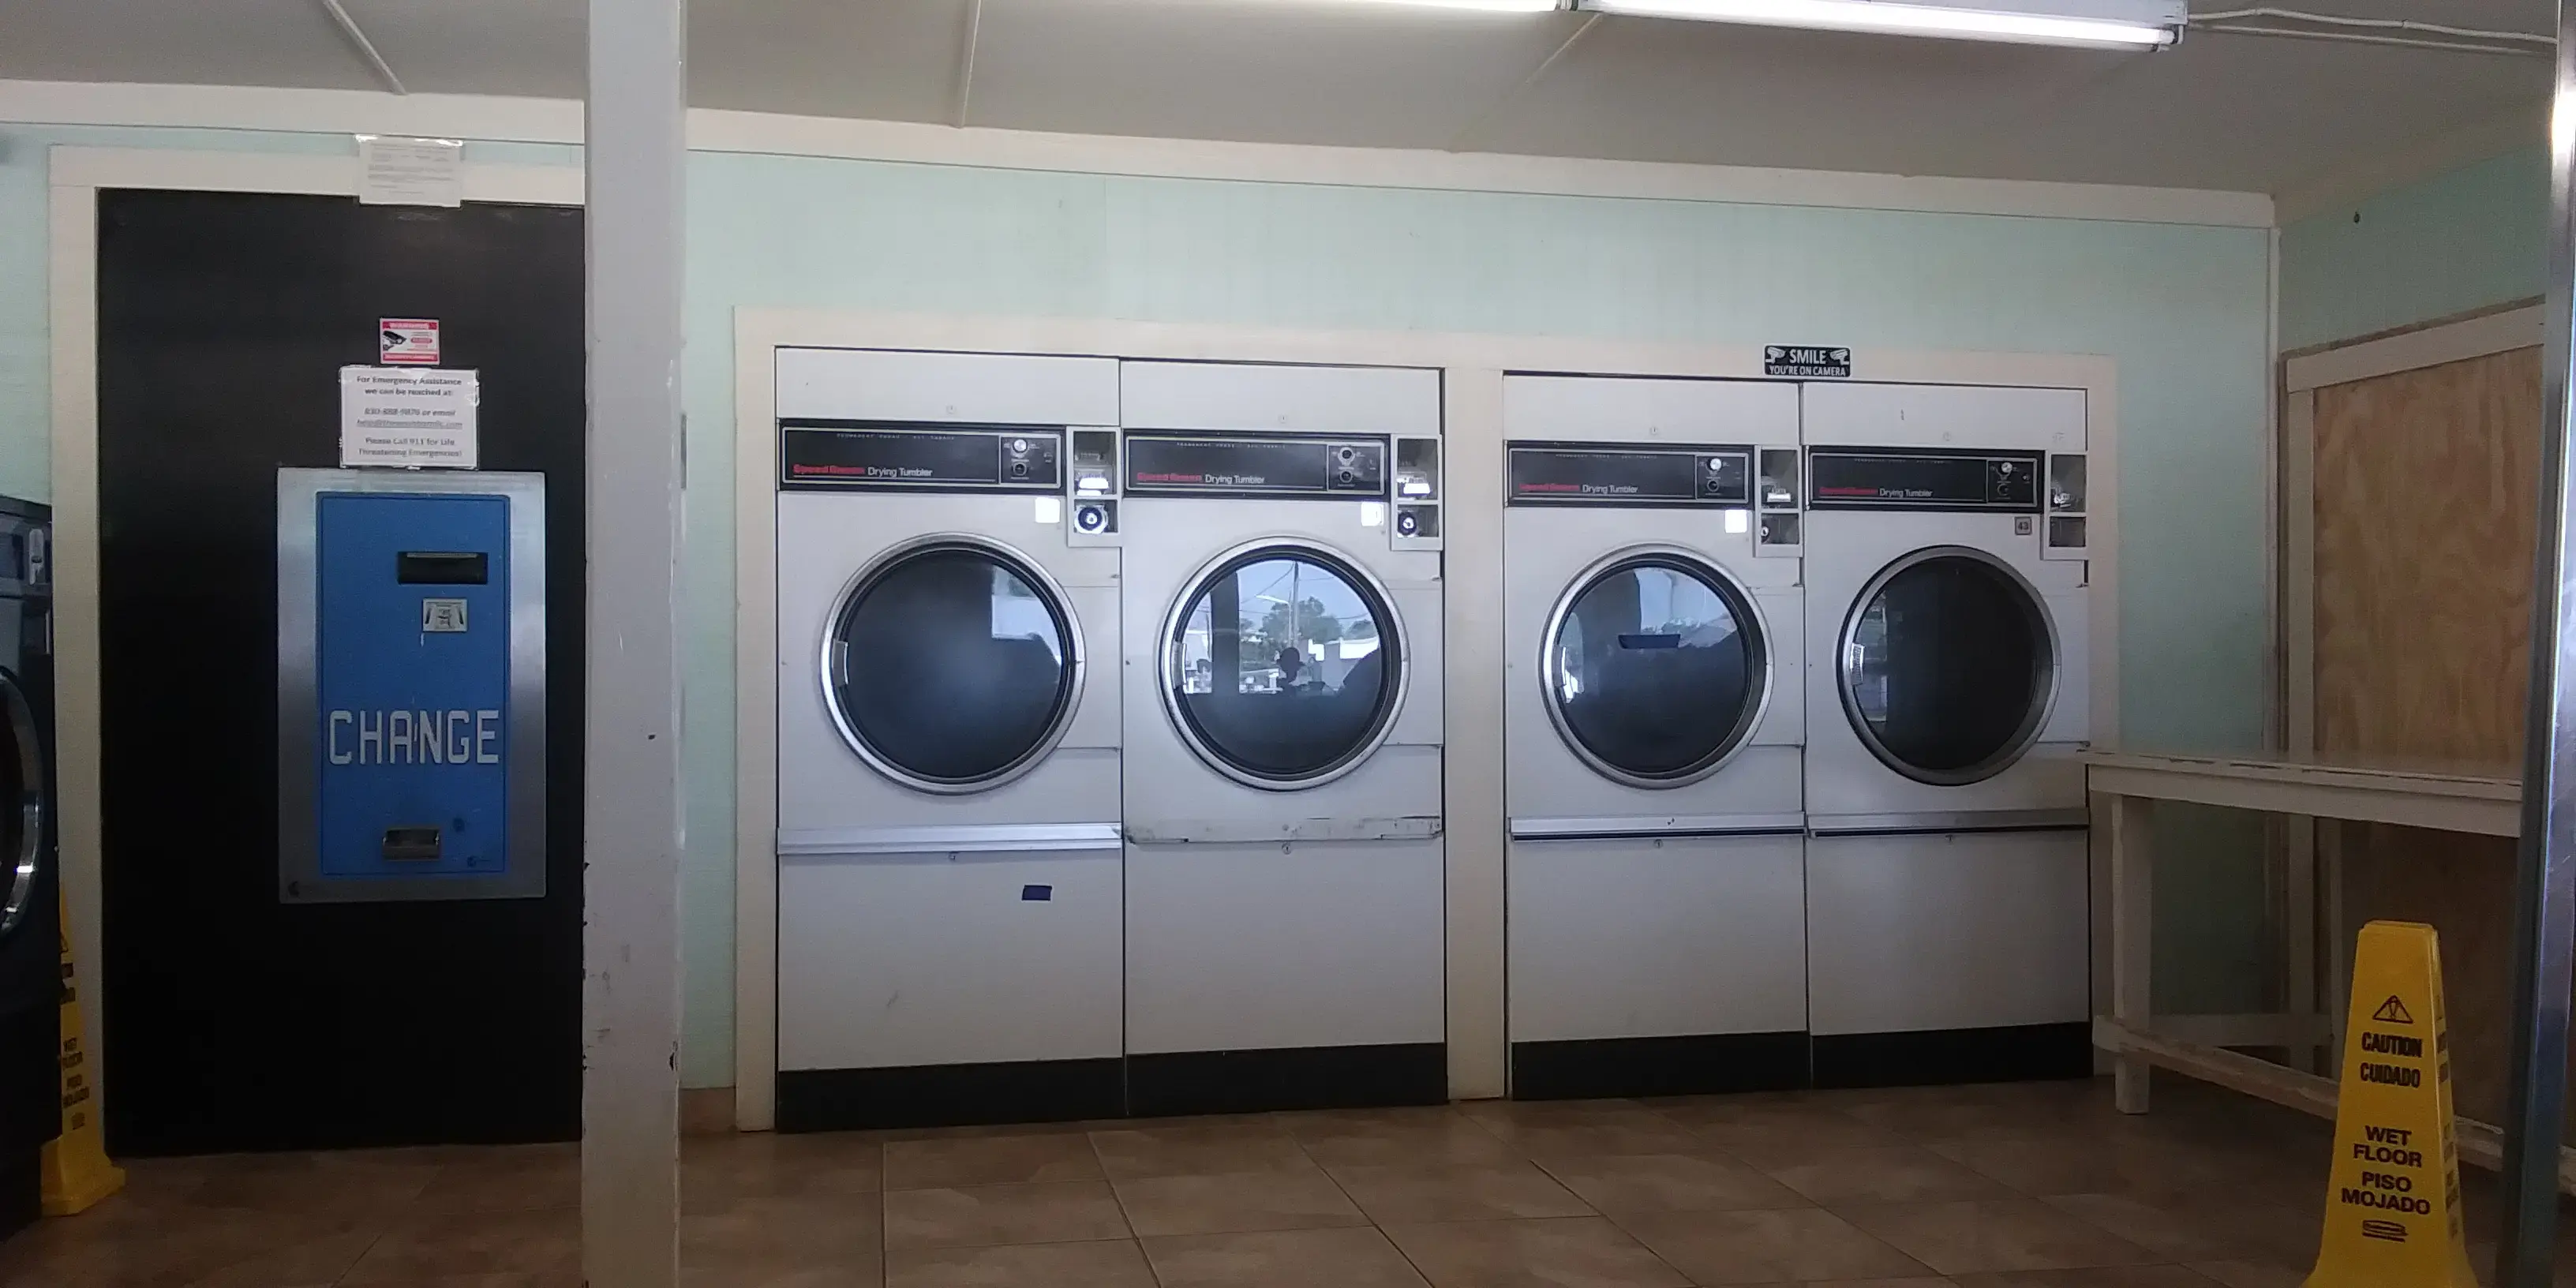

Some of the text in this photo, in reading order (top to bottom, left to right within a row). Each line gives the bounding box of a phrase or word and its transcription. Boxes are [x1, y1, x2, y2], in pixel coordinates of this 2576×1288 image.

[1789, 349, 1826, 365] SMILE
[1769, 365, 1846, 376] YOU'RE ON CAMERA
[373, 376, 417, 385] Emergency
[420, 377, 462, 386] Assistance
[867, 466, 897, 477] Drying
[900, 466, 933, 477] Tumbler
[1205, 474, 1232, 485] Drying
[1234, 475, 1264, 485] Tumbler
[1582, 484, 1608, 495] Drying
[1610, 485, 1638, 493] Tumbler
[1879, 488, 1904, 498] Drying
[1905, 489, 1933, 497] Tumbler
[329, 710, 499, 765] CHANGE
[2361, 1032, 2422, 1058] CAUTION
[2361, 1062, 2421, 1088] CUIDADO
[2365, 1125, 2412, 1146] WET
[2353, 1143, 2422, 1168] FLOOR
[2361, 1171, 2412, 1193] PISO
[2342, 1188, 2431, 1215] MOJADO
